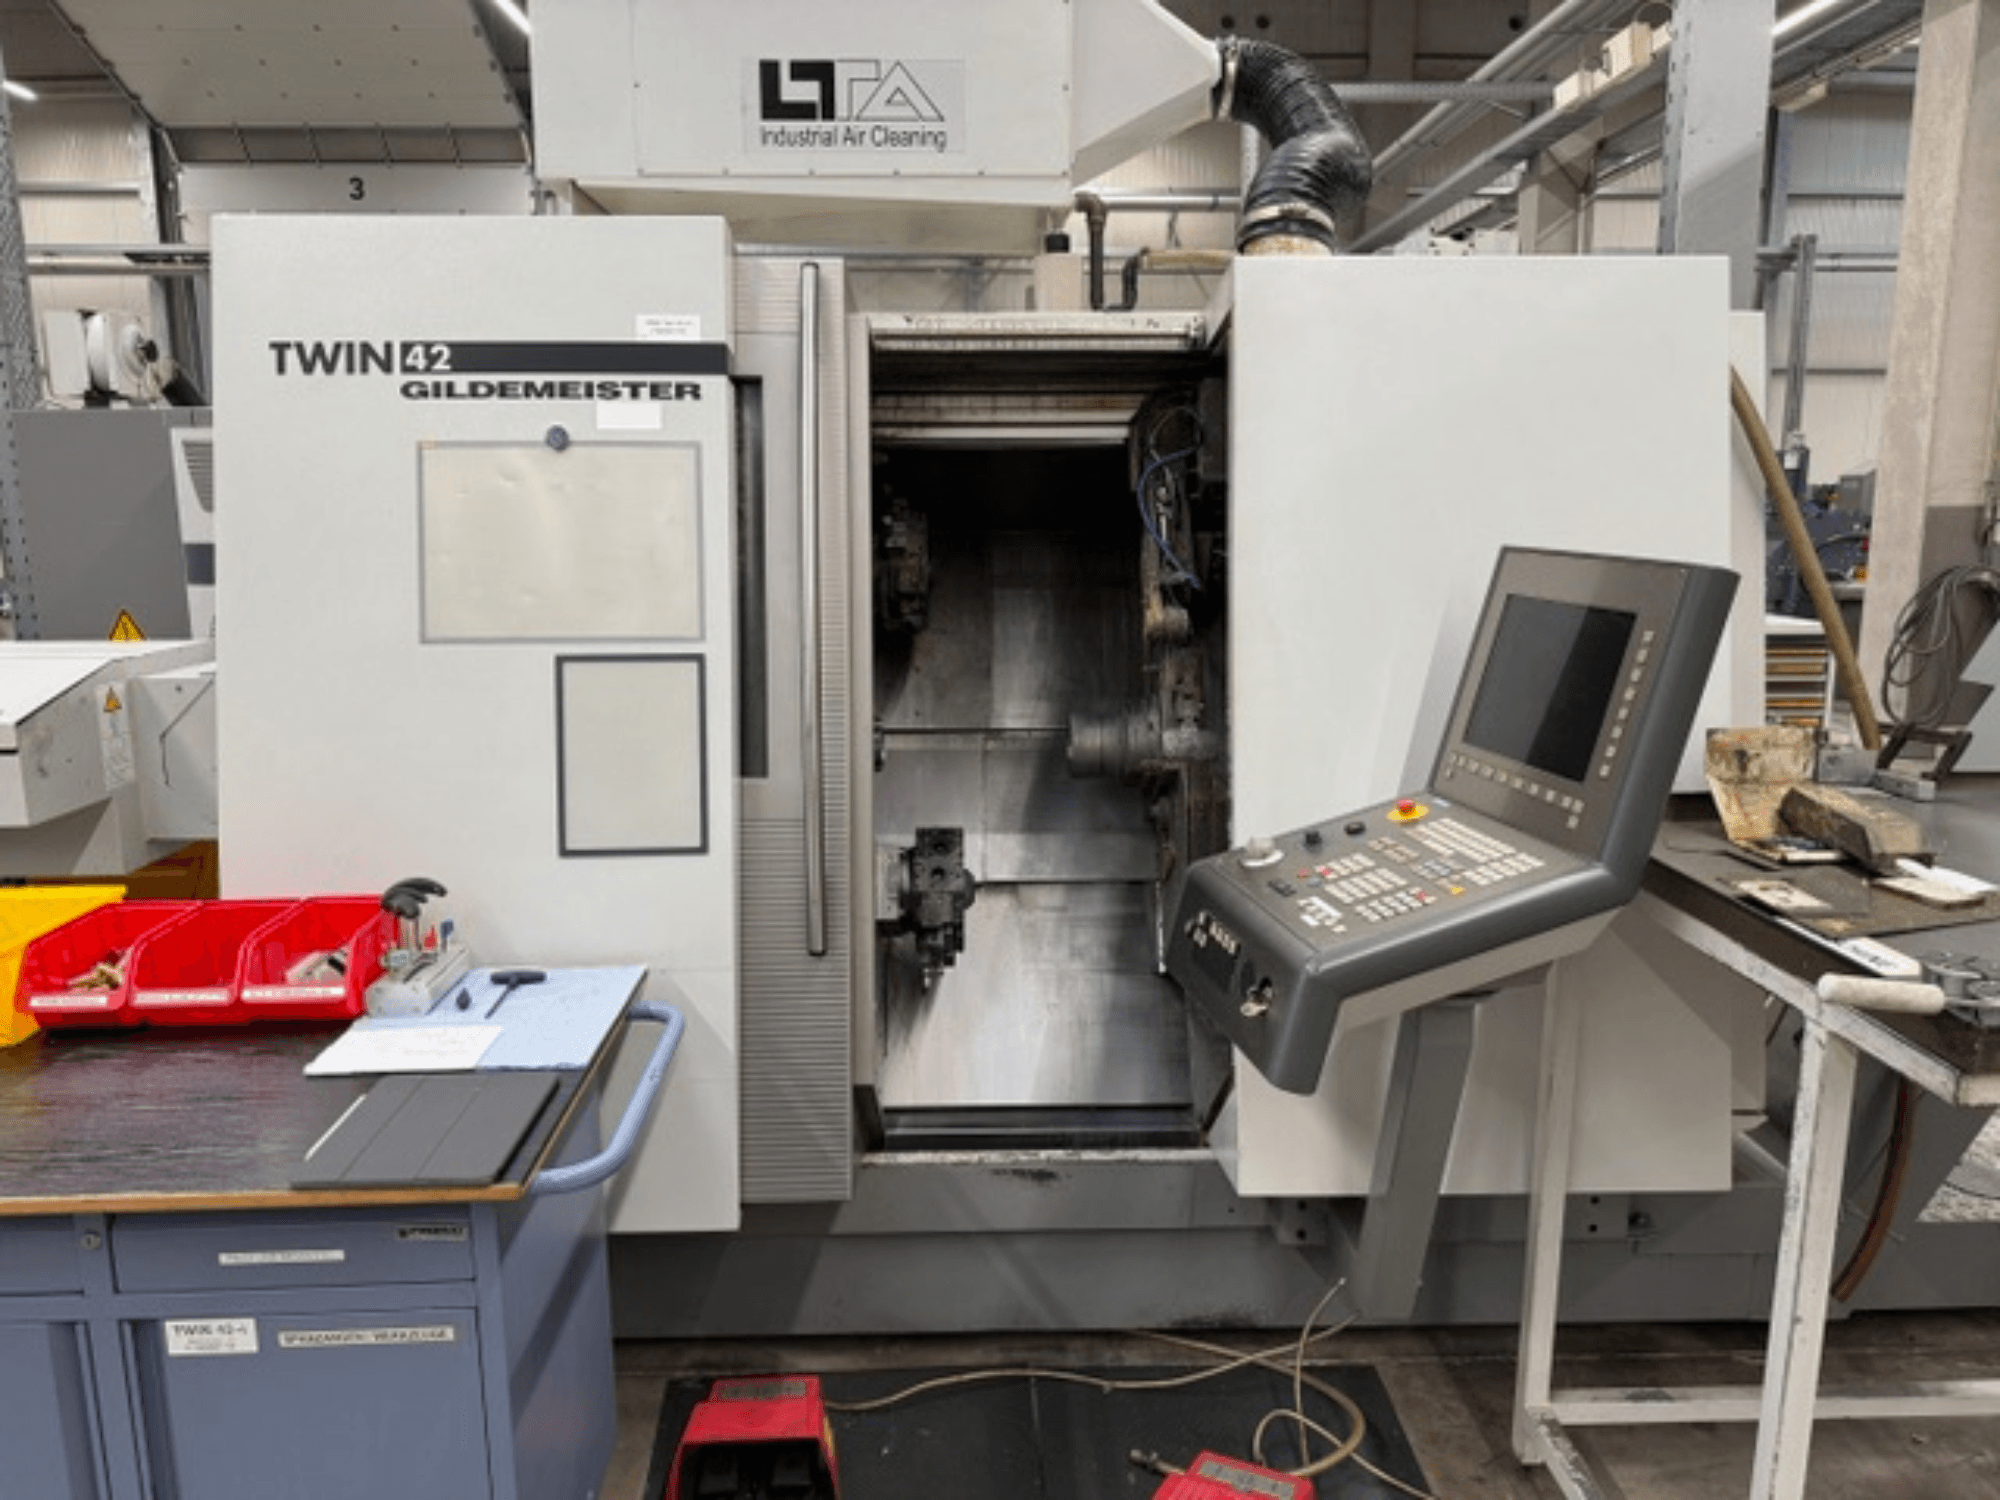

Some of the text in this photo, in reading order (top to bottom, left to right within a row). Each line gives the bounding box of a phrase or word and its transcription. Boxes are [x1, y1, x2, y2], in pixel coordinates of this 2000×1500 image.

[760, 125, 947, 153] Industrial Air Cleaning
[349, 177, 364, 201] 3
[268, 341, 452, 376] TWIN 42
[400, 380, 702, 401] GILDEMEISTER
